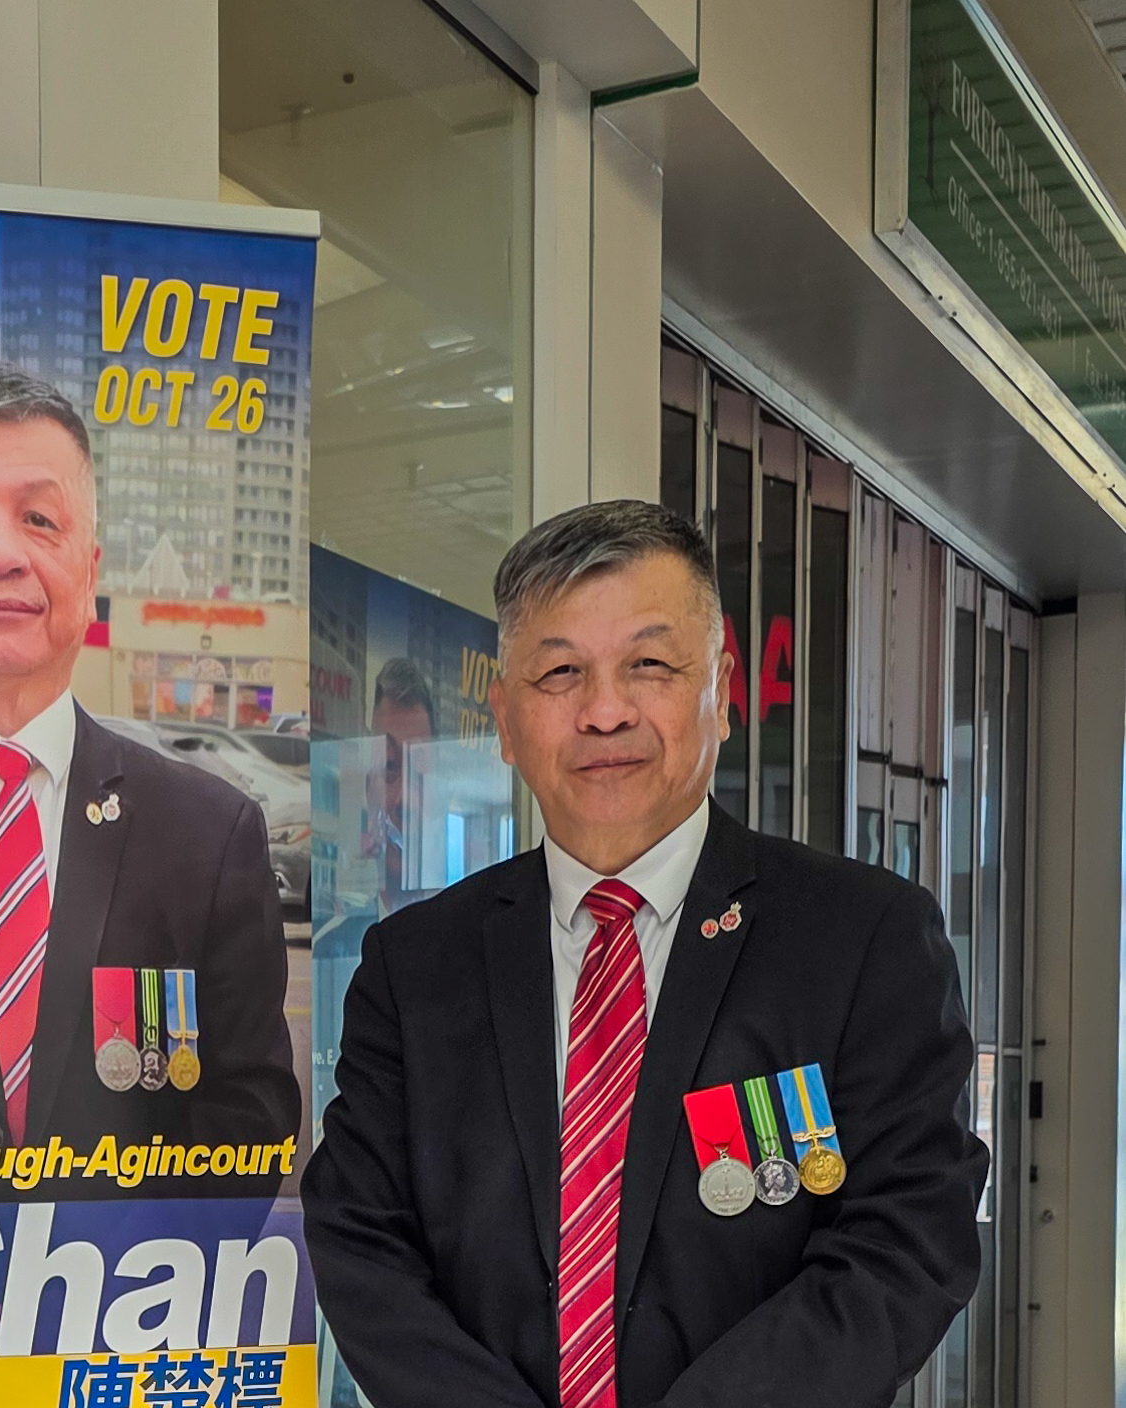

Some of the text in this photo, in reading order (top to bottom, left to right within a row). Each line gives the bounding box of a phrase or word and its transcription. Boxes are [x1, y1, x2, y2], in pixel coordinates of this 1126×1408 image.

[947, 176, 986, 253] Office:
[952, 59, 1015, 194] FOREIGN
[1018, 154, 1100, 308] IMMIGRATION
[101, 274, 280, 365] VOTE
[93, 365, 267, 435] OCT 26
